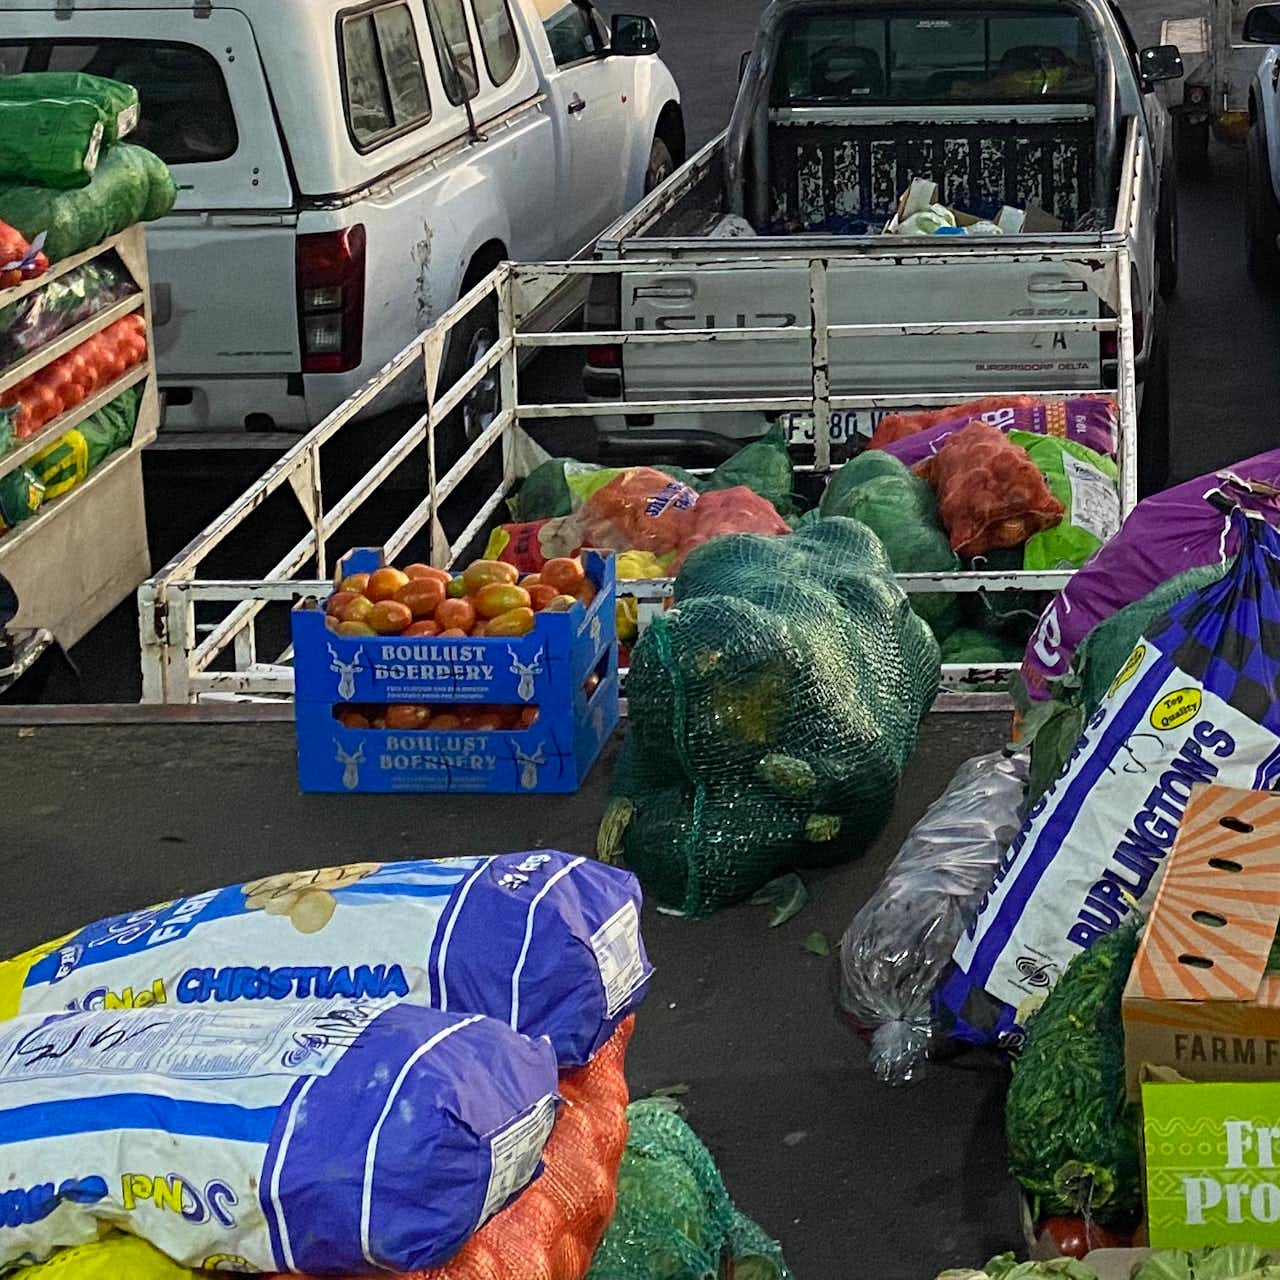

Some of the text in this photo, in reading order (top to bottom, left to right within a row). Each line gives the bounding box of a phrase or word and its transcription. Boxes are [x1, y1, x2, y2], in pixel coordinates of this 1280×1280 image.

[1058, 362, 1090, 371] DELTA
[374, 664, 494, 681] BOERDERY
[1164, 696, 1184, 710] Top
[1161, 703, 1197, 728] Quality
[379, 754, 497, 771] BOERDERY
[176, 964, 410, 1004] CHRISTIANA
[1174, 1033, 1258, 1066] FARM
